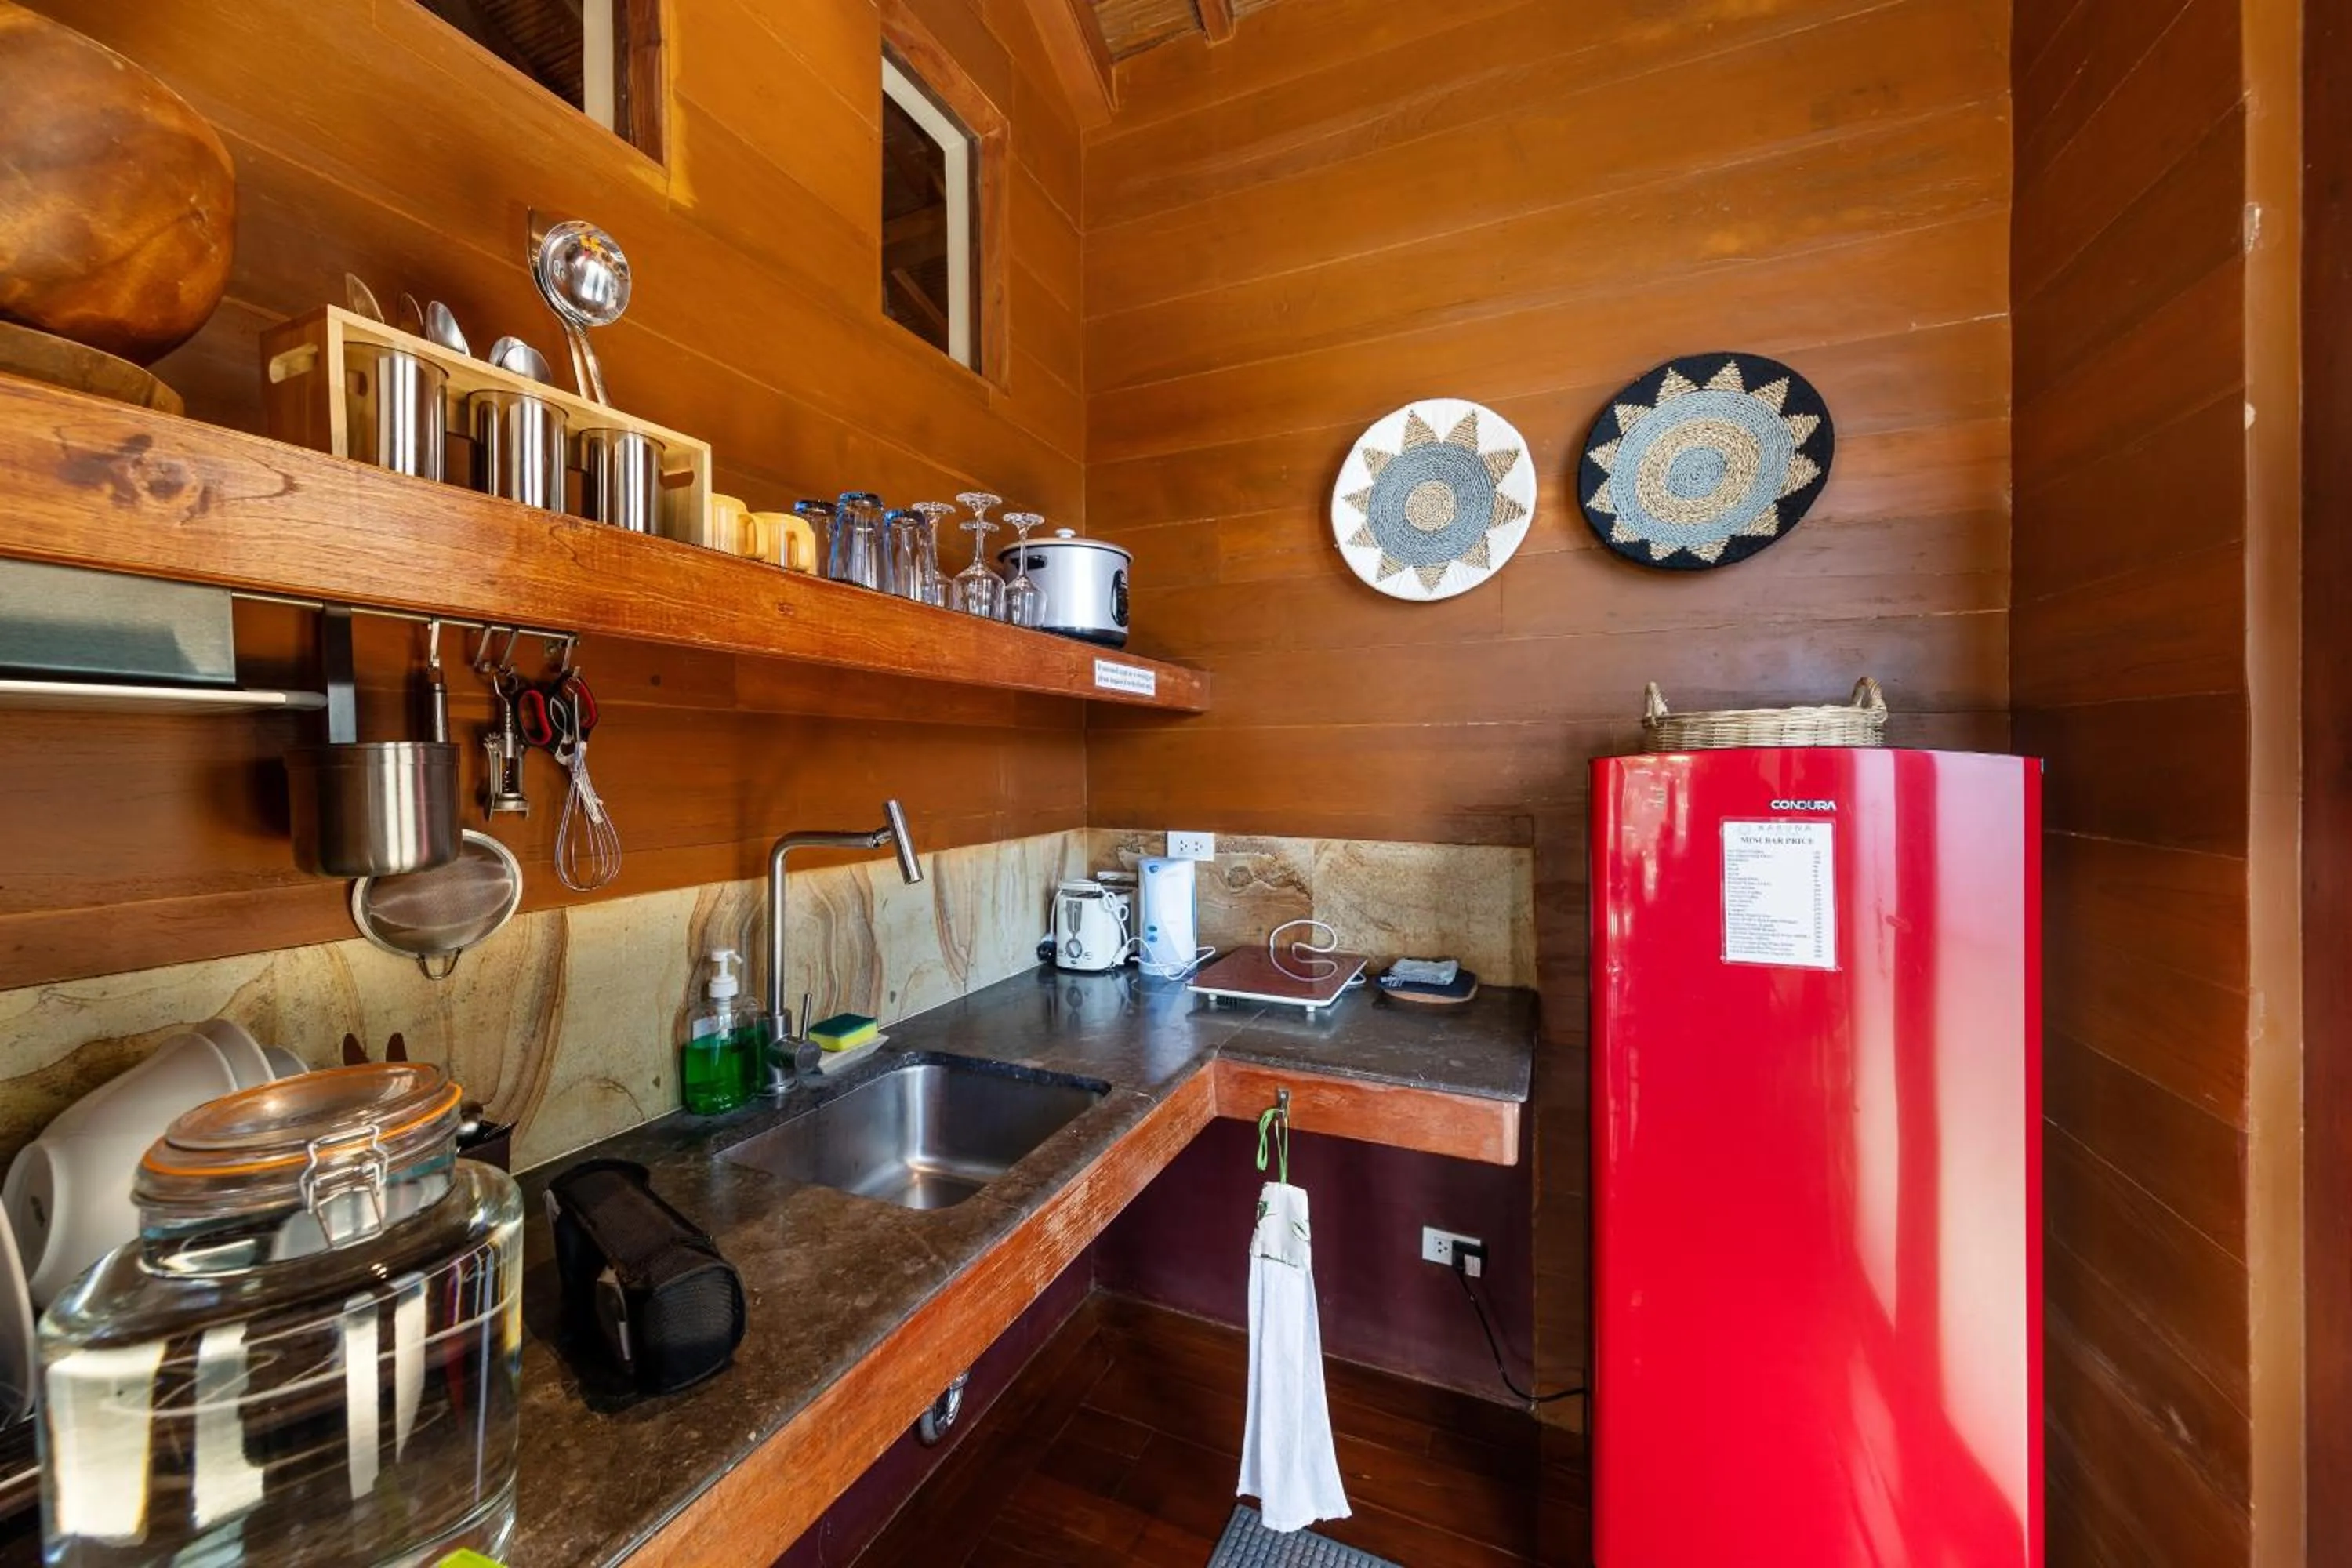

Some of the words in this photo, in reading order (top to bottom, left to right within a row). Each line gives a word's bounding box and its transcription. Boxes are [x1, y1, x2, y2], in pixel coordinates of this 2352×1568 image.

[1770, 800, 1837, 811] CONDURA
[1740, 836, 1763, 844] MINI
[1785, 837, 1814, 845] PRICE
